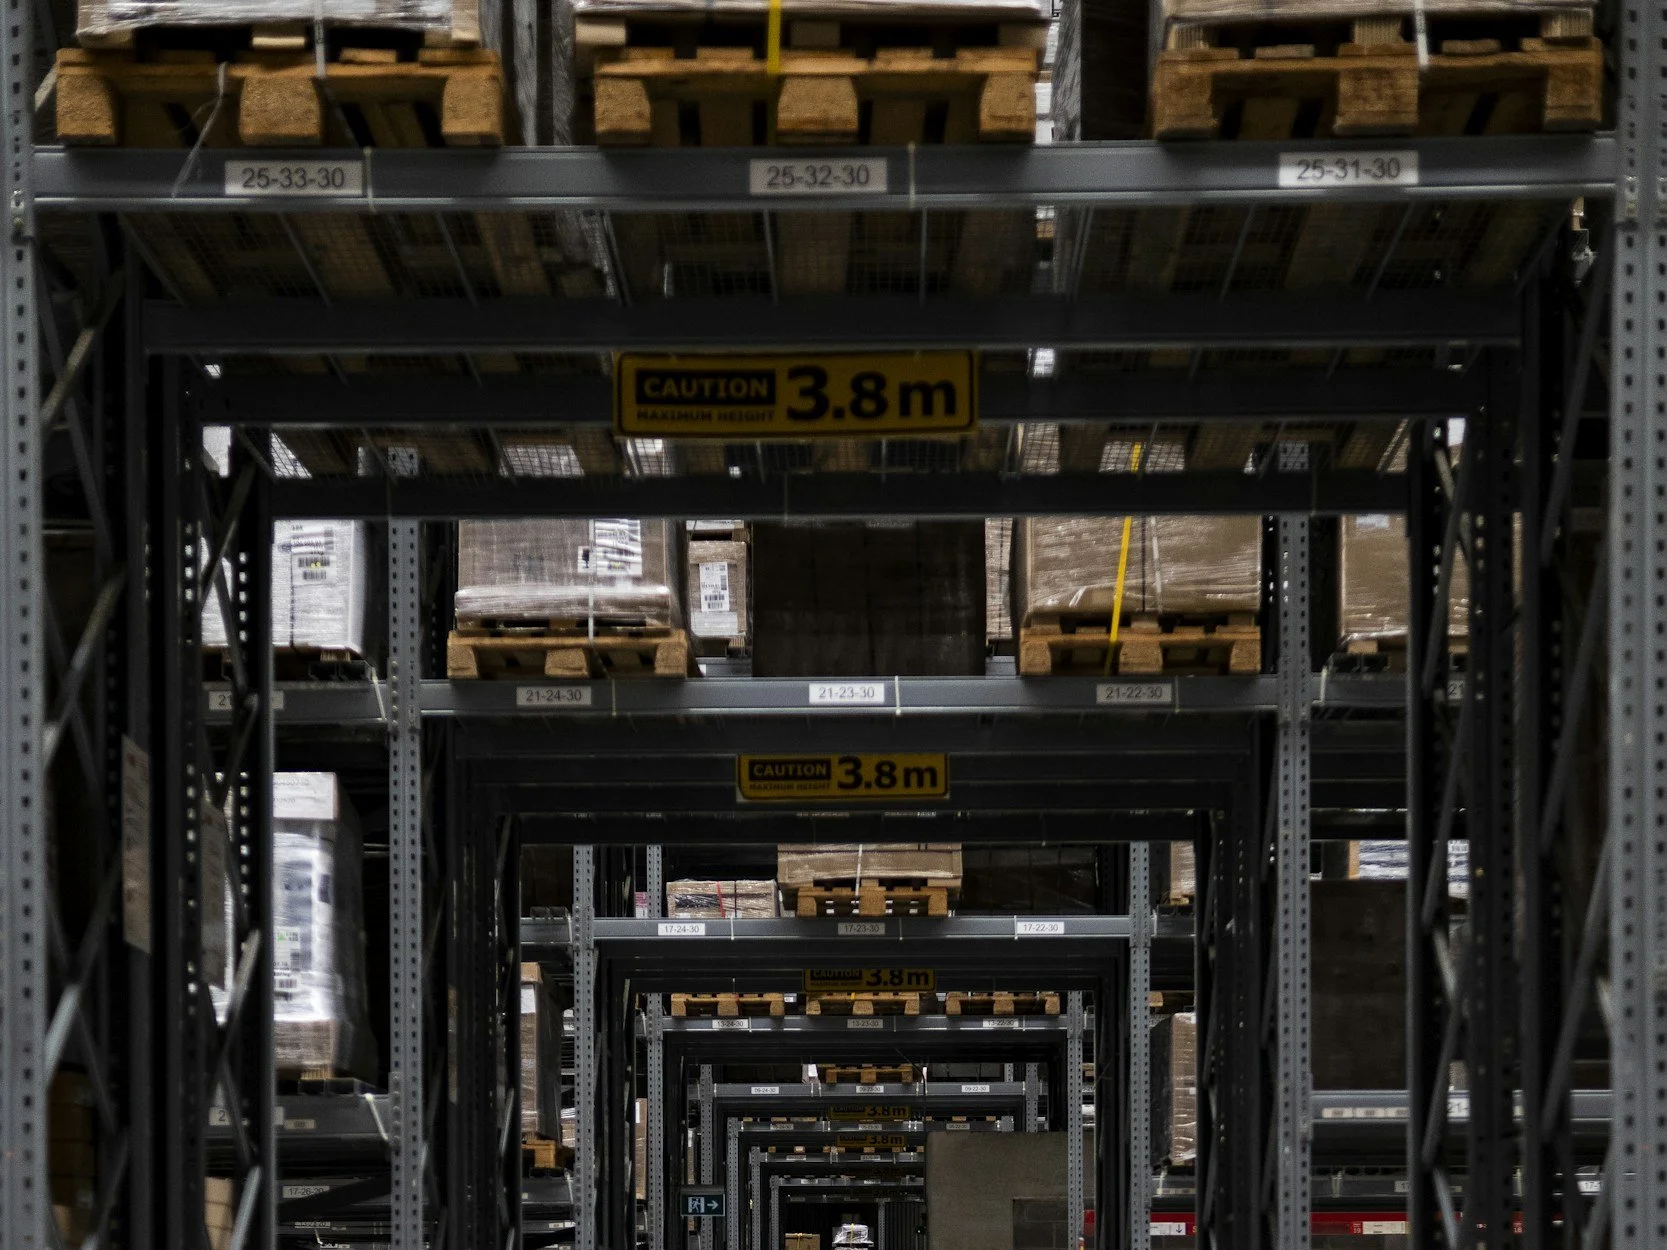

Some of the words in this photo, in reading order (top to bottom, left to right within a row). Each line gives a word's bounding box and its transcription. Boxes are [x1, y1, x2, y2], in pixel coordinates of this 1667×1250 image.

[767, 164, 870, 187] 25-32-30
[1297, 157, 1401, 180] 25-31-30
[242, 166, 345, 188] 25-33-30
[643, 376, 769, 401] CAUTION
[526, 689, 582, 701] 21-24-30
[819, 686, 875, 698] 21-23-30
[1105, 687, 1163, 699] 21-22-30
[752, 763, 828, 777] CAUTION
[664, 925, 700, 934] 17-24-30
